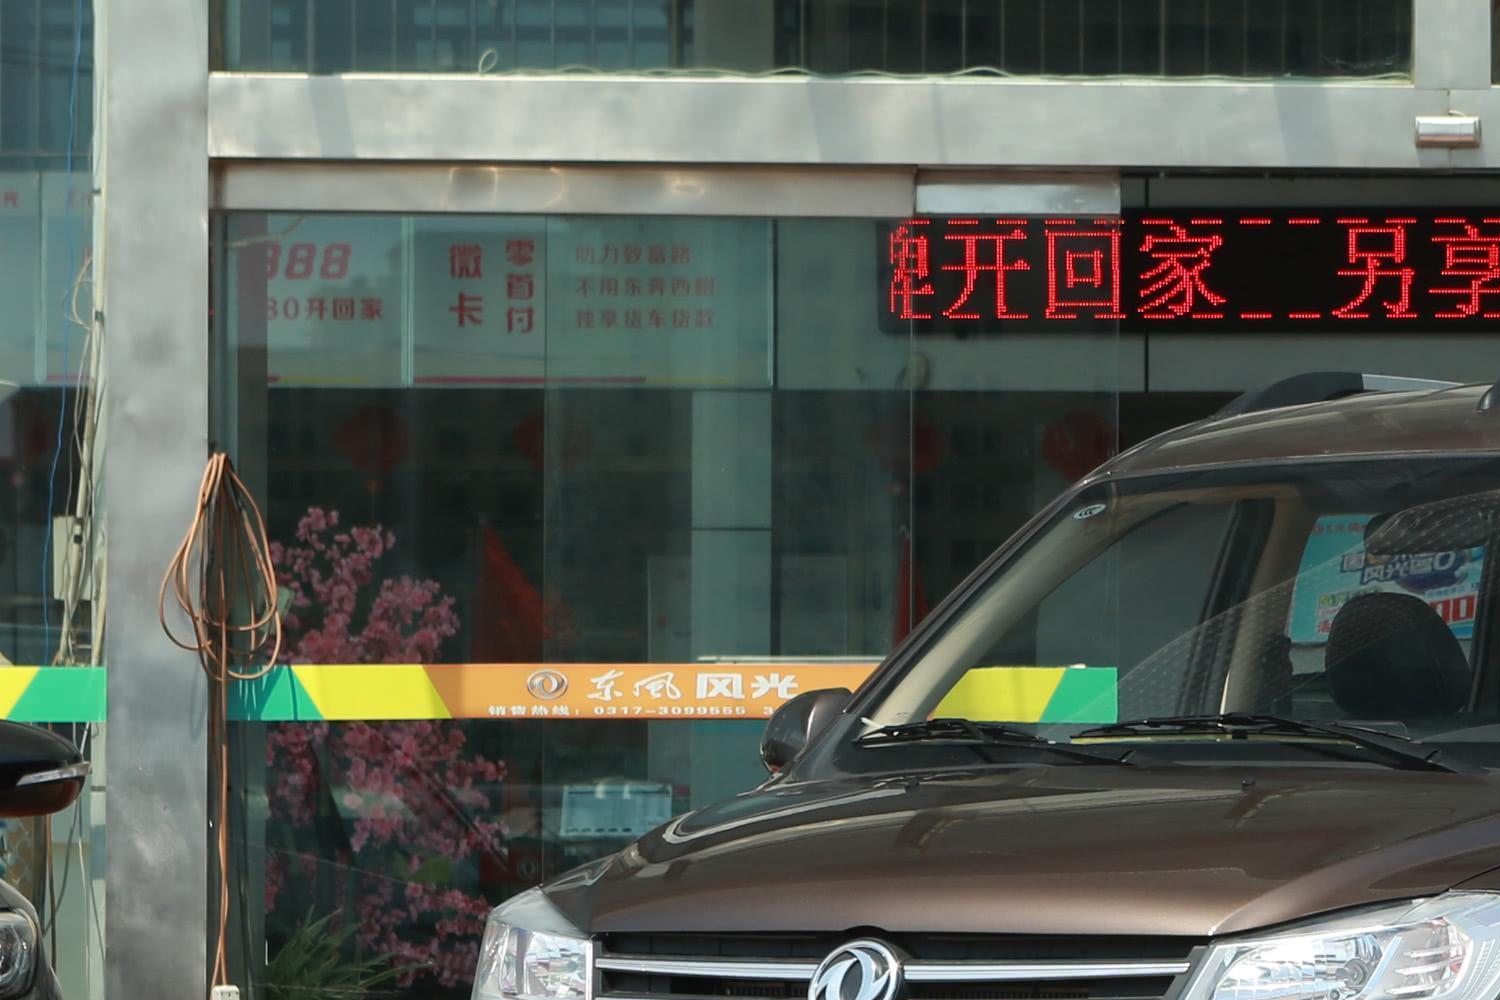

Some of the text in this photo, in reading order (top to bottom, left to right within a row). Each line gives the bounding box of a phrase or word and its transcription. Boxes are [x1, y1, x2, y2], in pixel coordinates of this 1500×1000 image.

[449, 243, 483, 327] 微卡
[506, 239, 535, 333] 零首付
